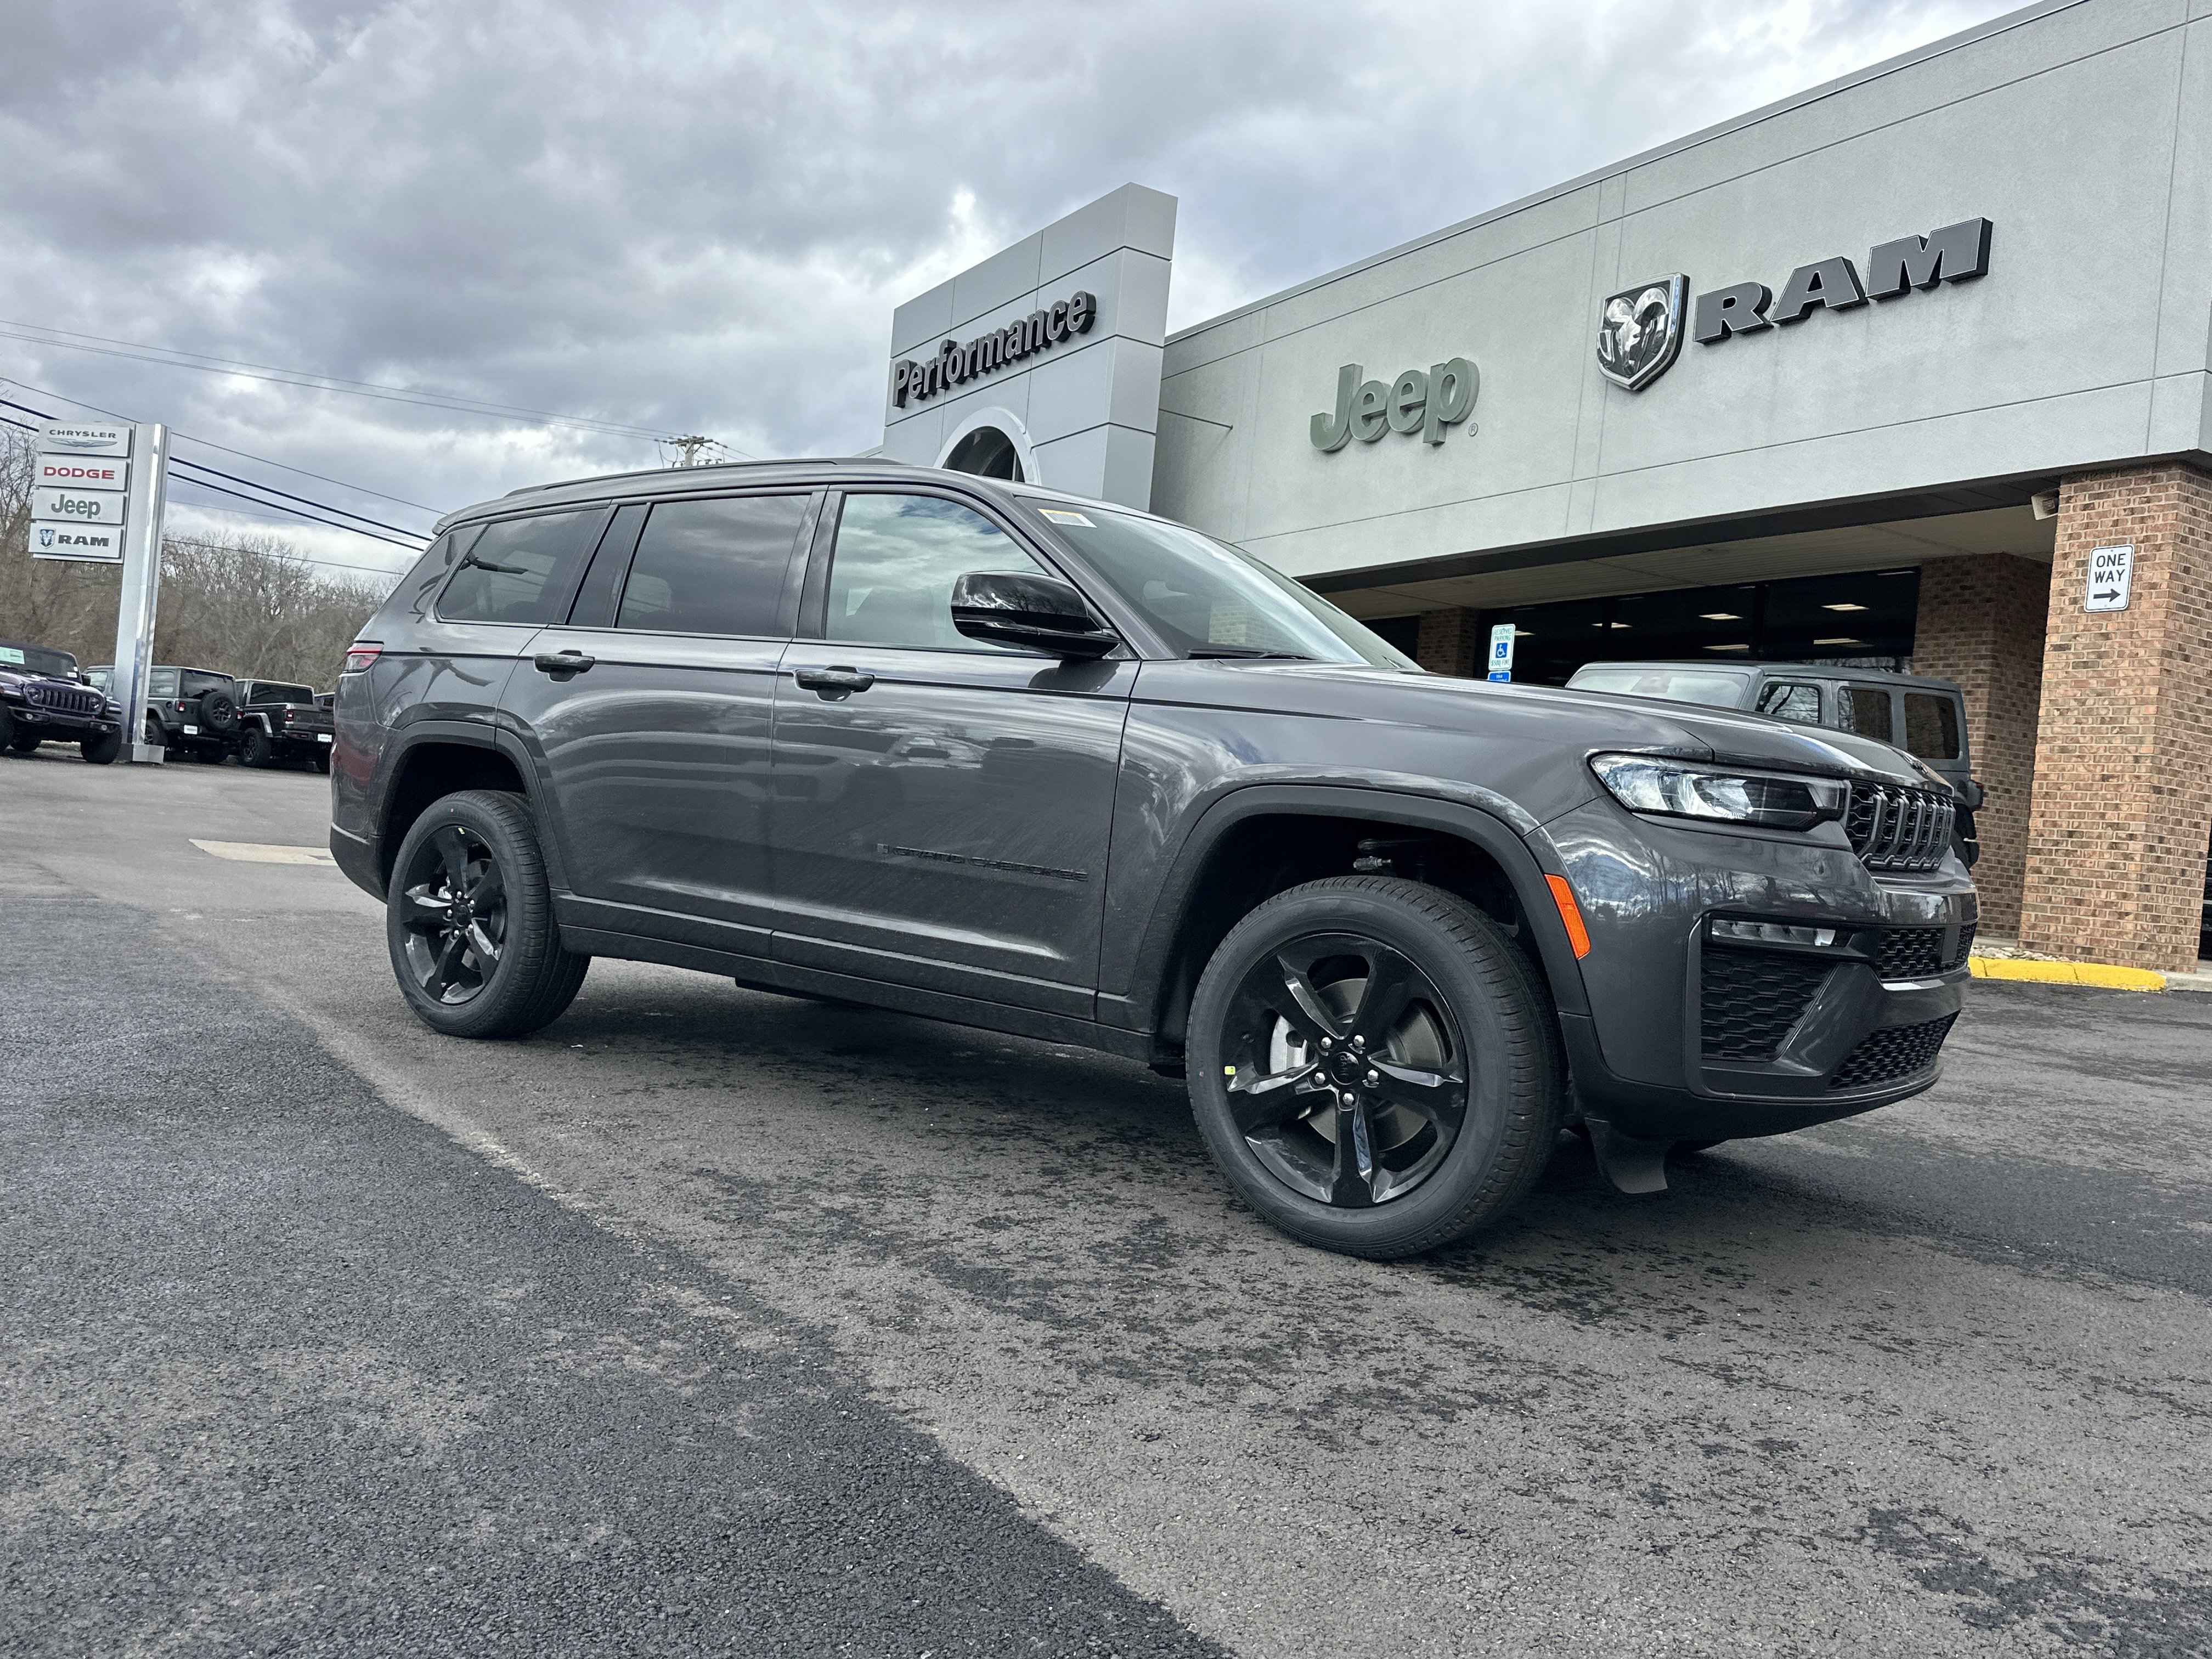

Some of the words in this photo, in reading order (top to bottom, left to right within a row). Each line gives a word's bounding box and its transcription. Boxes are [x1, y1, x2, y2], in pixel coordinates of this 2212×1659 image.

[1692, 217, 1994, 345] RAM
[892, 290, 1096, 408] Performance
[1310, 357, 1480, 452] Jeep
[49, 429, 116, 439] CHRYSLER
[44, 466, 115, 480] DODGE
[51, 494, 101, 519] Jeep
[58, 534, 110, 547] RAM
[2096, 553, 2126, 567] ONE
[2095, 569, 2125, 583] WAY
